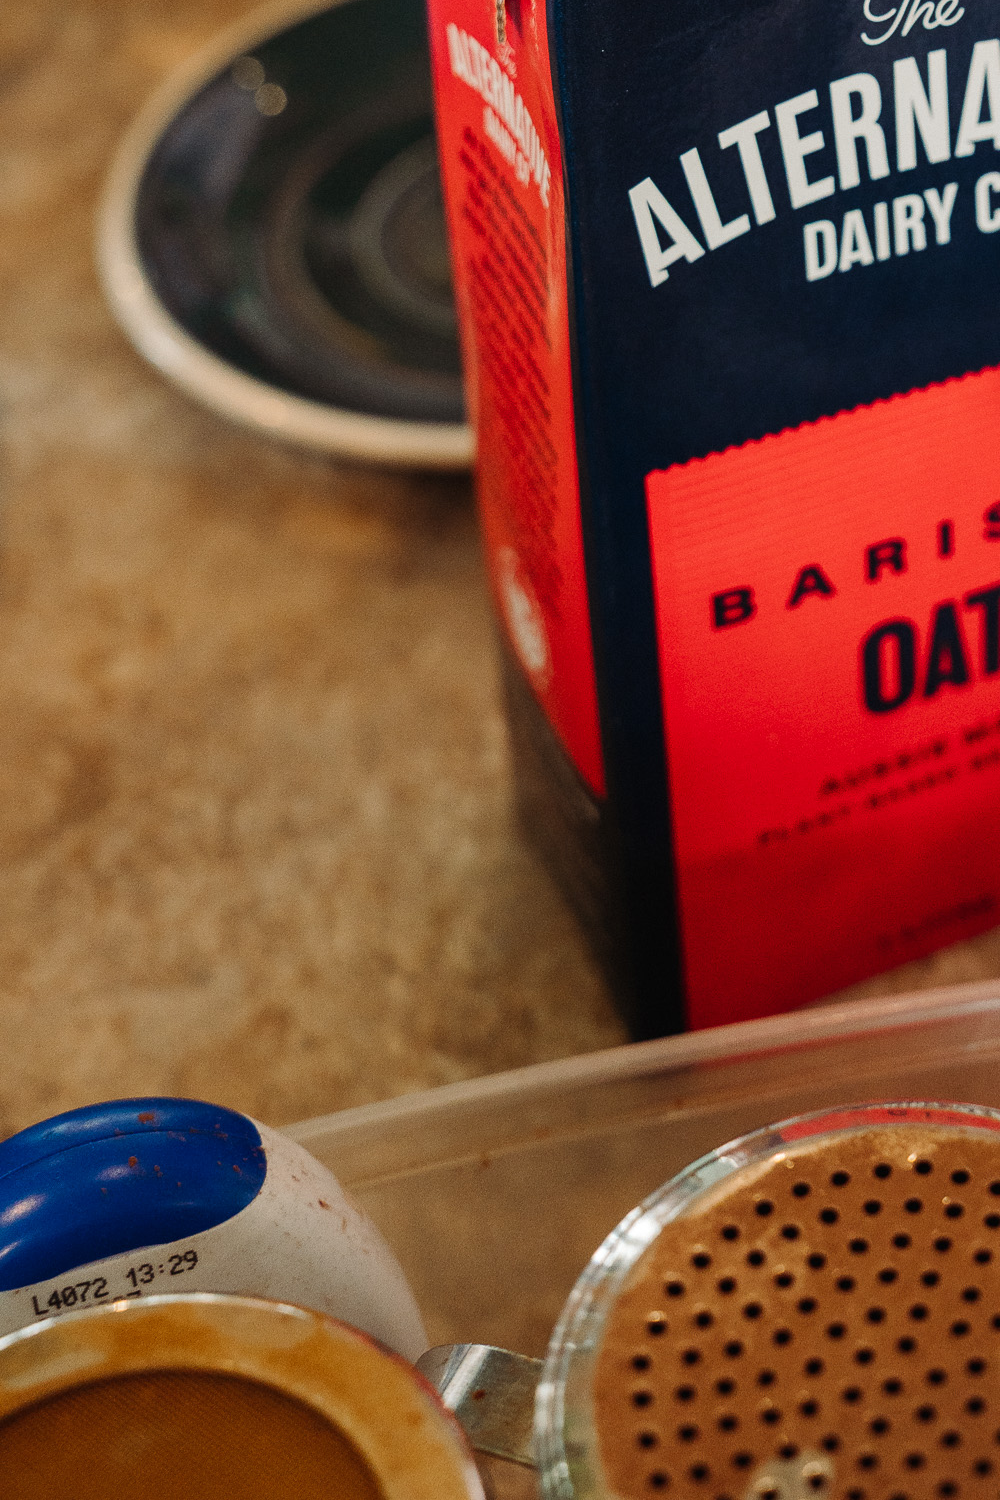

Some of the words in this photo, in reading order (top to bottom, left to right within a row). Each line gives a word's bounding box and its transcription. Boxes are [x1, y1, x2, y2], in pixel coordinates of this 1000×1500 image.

[803, 183, 958, 282] DAIRY
[32, 1276, 109, 1316] L4072
[126, 1250, 198, 1287] 13:29
